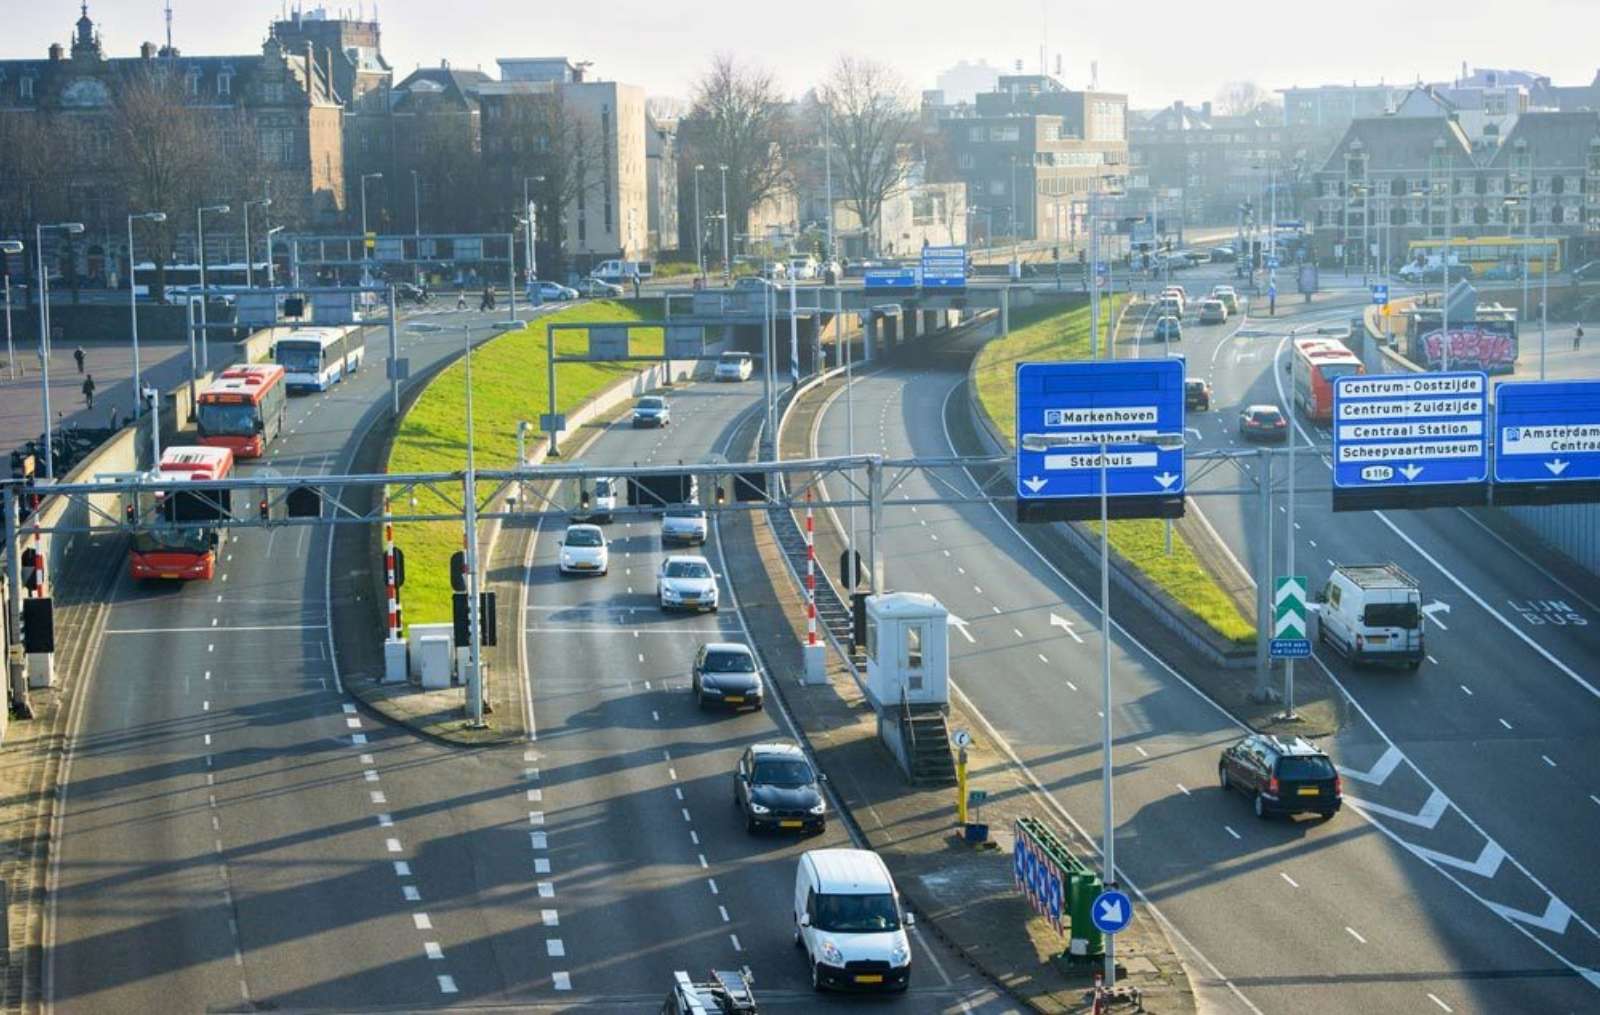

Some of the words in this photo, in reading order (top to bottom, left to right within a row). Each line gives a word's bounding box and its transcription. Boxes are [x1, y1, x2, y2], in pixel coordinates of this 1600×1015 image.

[1063, 411, 1154, 422] Markenhoven
[1353, 426, 1413, 437] Centraal
[1418, 424, 1468, 434] Station
[1343, 443, 1479, 458] Scheepvaartmuseum
[1070, 455, 1132, 467] Stadhuis
[1507, 600, 1573, 612] LIJN
[1522, 613, 1588, 625] BUS
